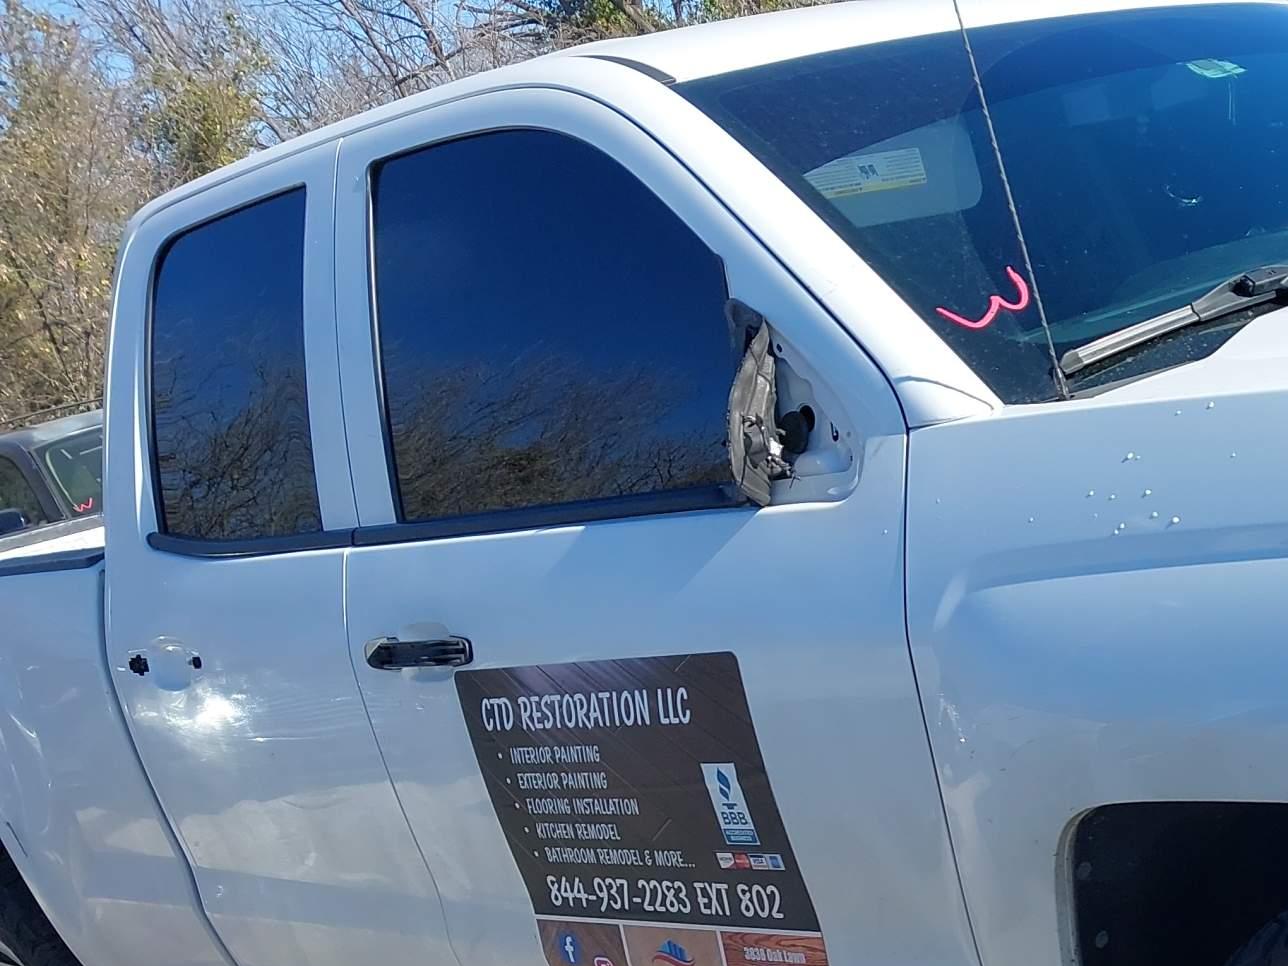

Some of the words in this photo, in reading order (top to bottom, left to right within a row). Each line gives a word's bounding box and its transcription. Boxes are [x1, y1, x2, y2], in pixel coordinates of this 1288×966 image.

[481, 697, 514, 731] CTD
[518, 689, 651, 731] RESTORATION
[657, 687, 691, 725] LLC
[510, 746, 553, 765] INTERIOR
[553, 745, 600, 764] PAINTING
[517, 773, 559, 790] EXTERIOR
[561, 772, 608, 790] PAINTING
[526, 798, 571, 815] FLOORING
[573, 798, 640, 816] INSTALLATION
[720, 811, 748, 825] BBB
[535, 823, 575, 840] KITCHEN
[576, 823, 621, 841] REMODEL
[545, 847, 596, 864] BATHROOM
[599, 849, 643, 866] REMODEL
[644, 850, 653, 866] &
[654, 850, 696, 868] MORE...
[547, 875, 691, 914] 844-937-2283
[693, 882, 731, 916] EXT
[736, 884, 784, 919] 802
